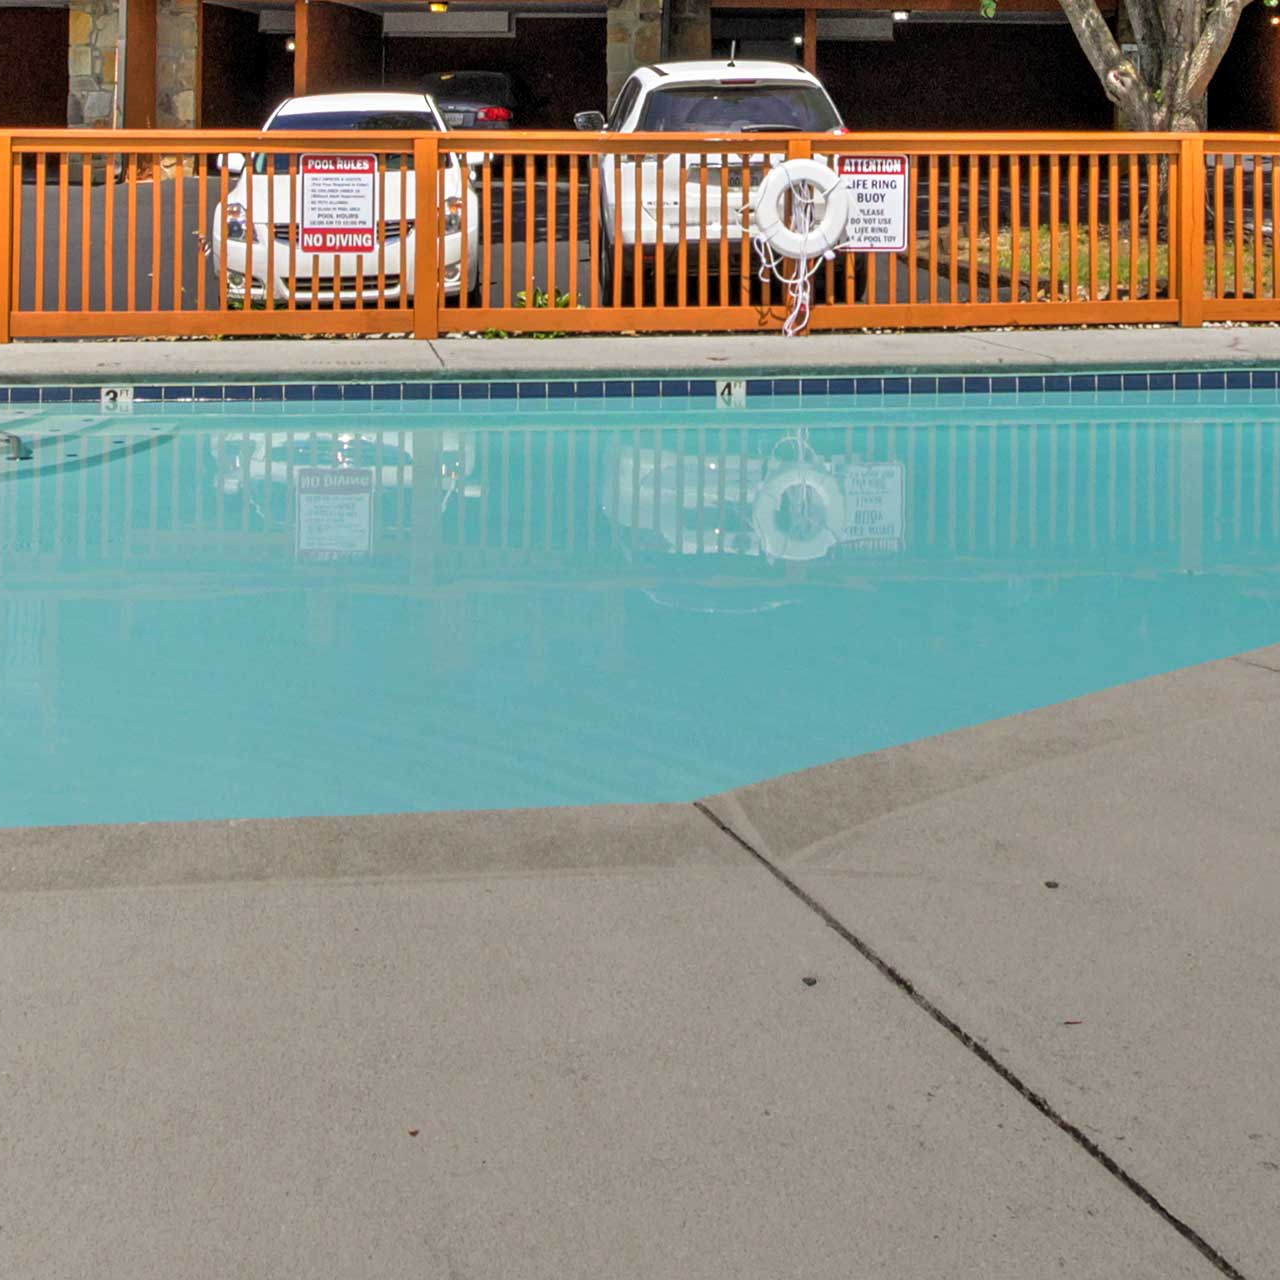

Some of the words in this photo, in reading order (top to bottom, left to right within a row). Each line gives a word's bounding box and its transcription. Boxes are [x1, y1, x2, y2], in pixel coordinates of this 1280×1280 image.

[308, 160, 334, 170] POOL
[337, 160, 370, 170] RULES
[843, 159, 901, 173] ATTENTION
[871, 180, 897, 190] RING
[857, 193, 886, 203] BUOY
[304, 233, 323, 247] NO
[326, 233, 372, 247] DIVING
[864, 235, 881, 243] POOL
[884, 235, 896, 243] TOY
